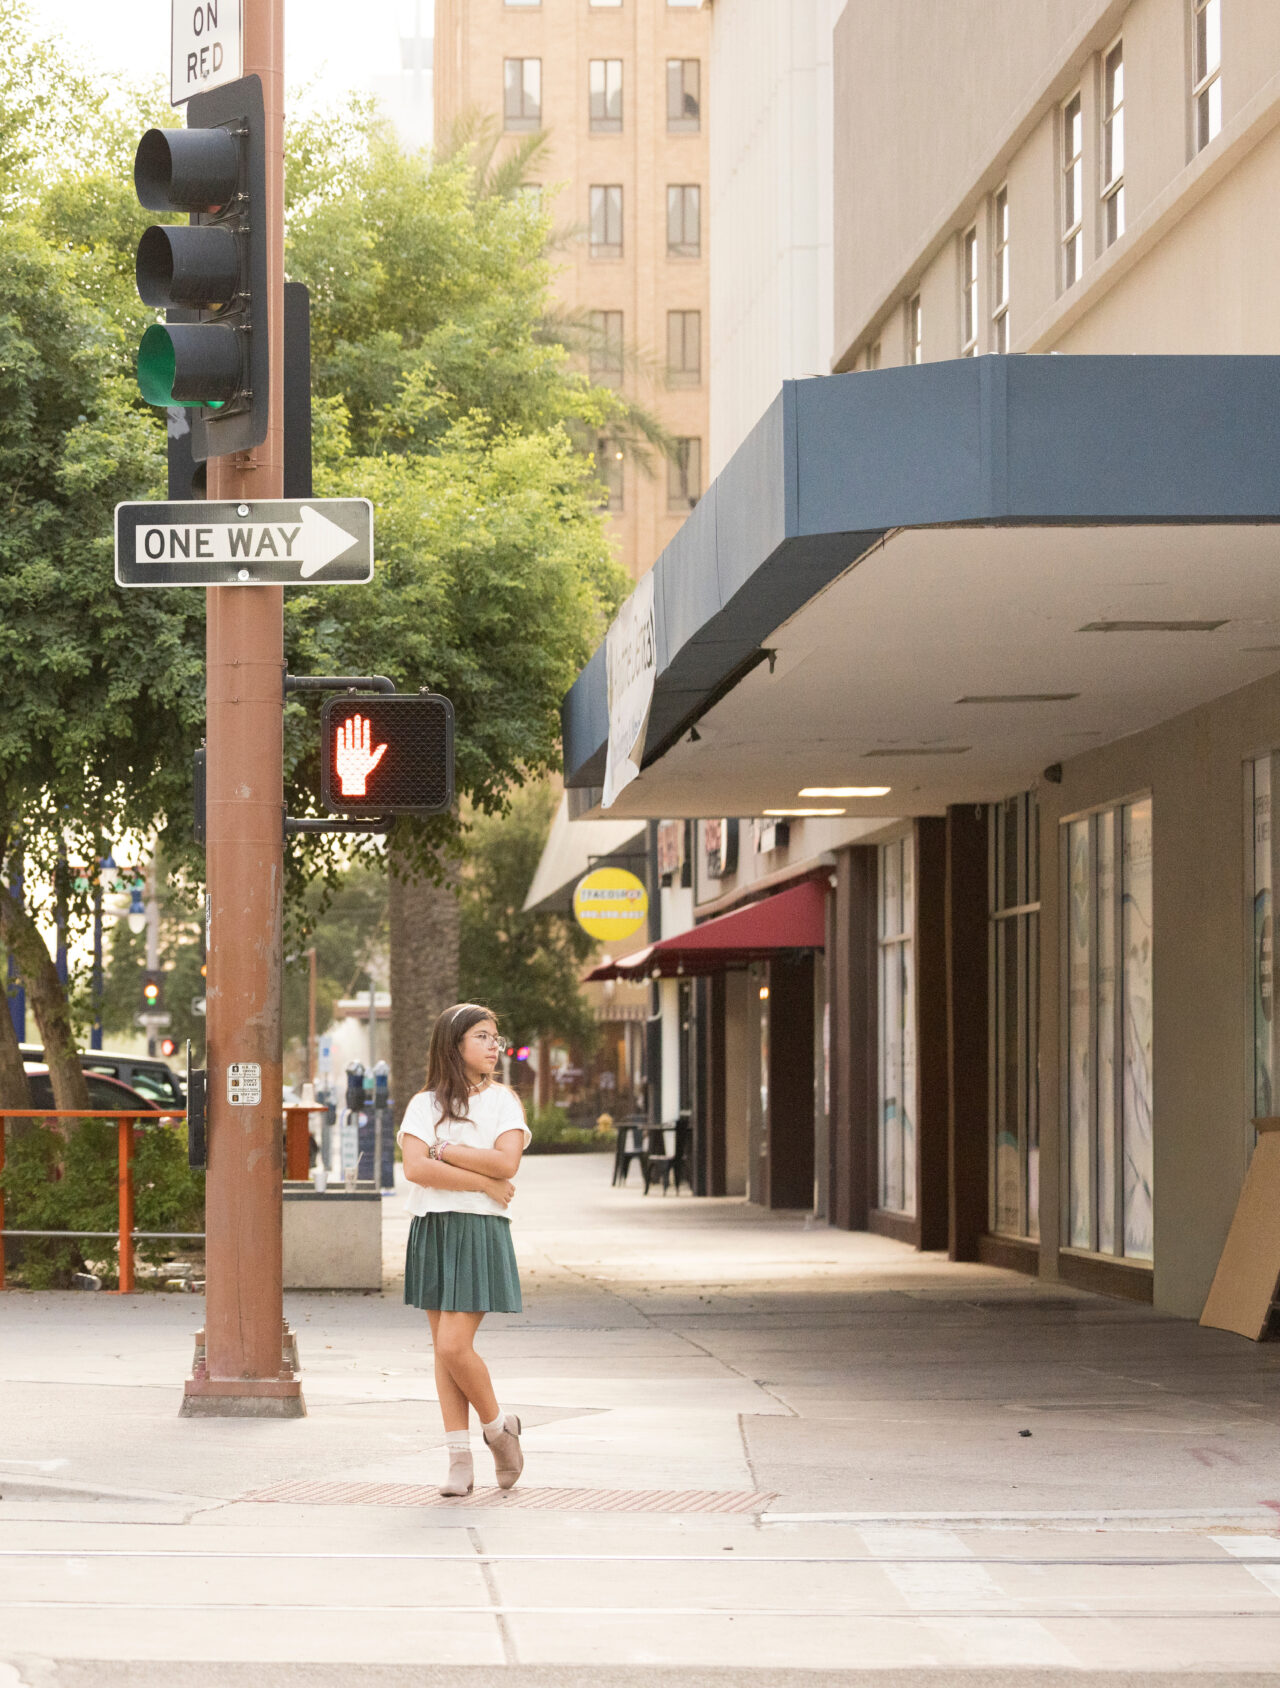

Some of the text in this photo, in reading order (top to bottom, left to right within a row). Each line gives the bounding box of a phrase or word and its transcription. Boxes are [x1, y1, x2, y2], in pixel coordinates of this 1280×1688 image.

[193, 0, 218, 37] ON
[187, 42, 224, 83] RED
[144, 526, 301, 560] ONE WAY
